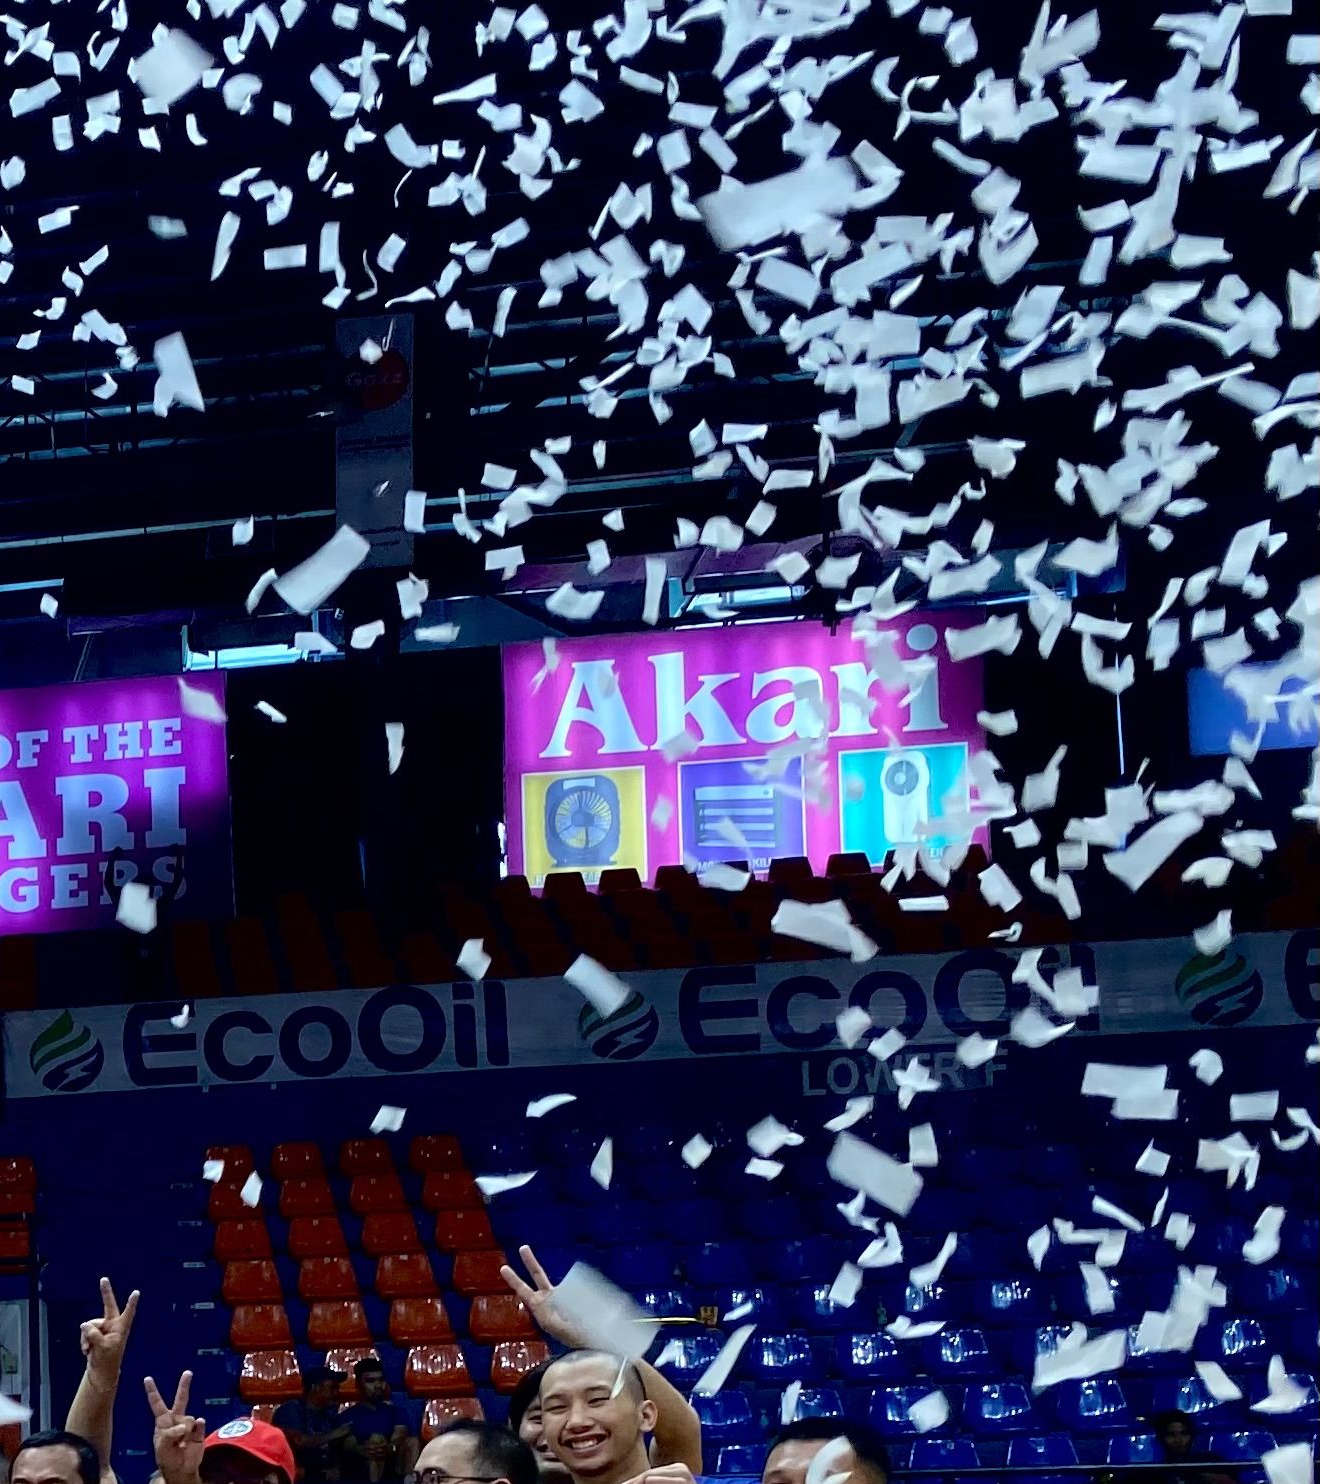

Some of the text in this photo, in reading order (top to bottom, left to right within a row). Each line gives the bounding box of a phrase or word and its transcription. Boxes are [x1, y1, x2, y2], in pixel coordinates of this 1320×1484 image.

[63, 717, 182, 763] THE
[539, 624, 949, 760] Akari
[123, 979, 509, 1086] EcoOil
